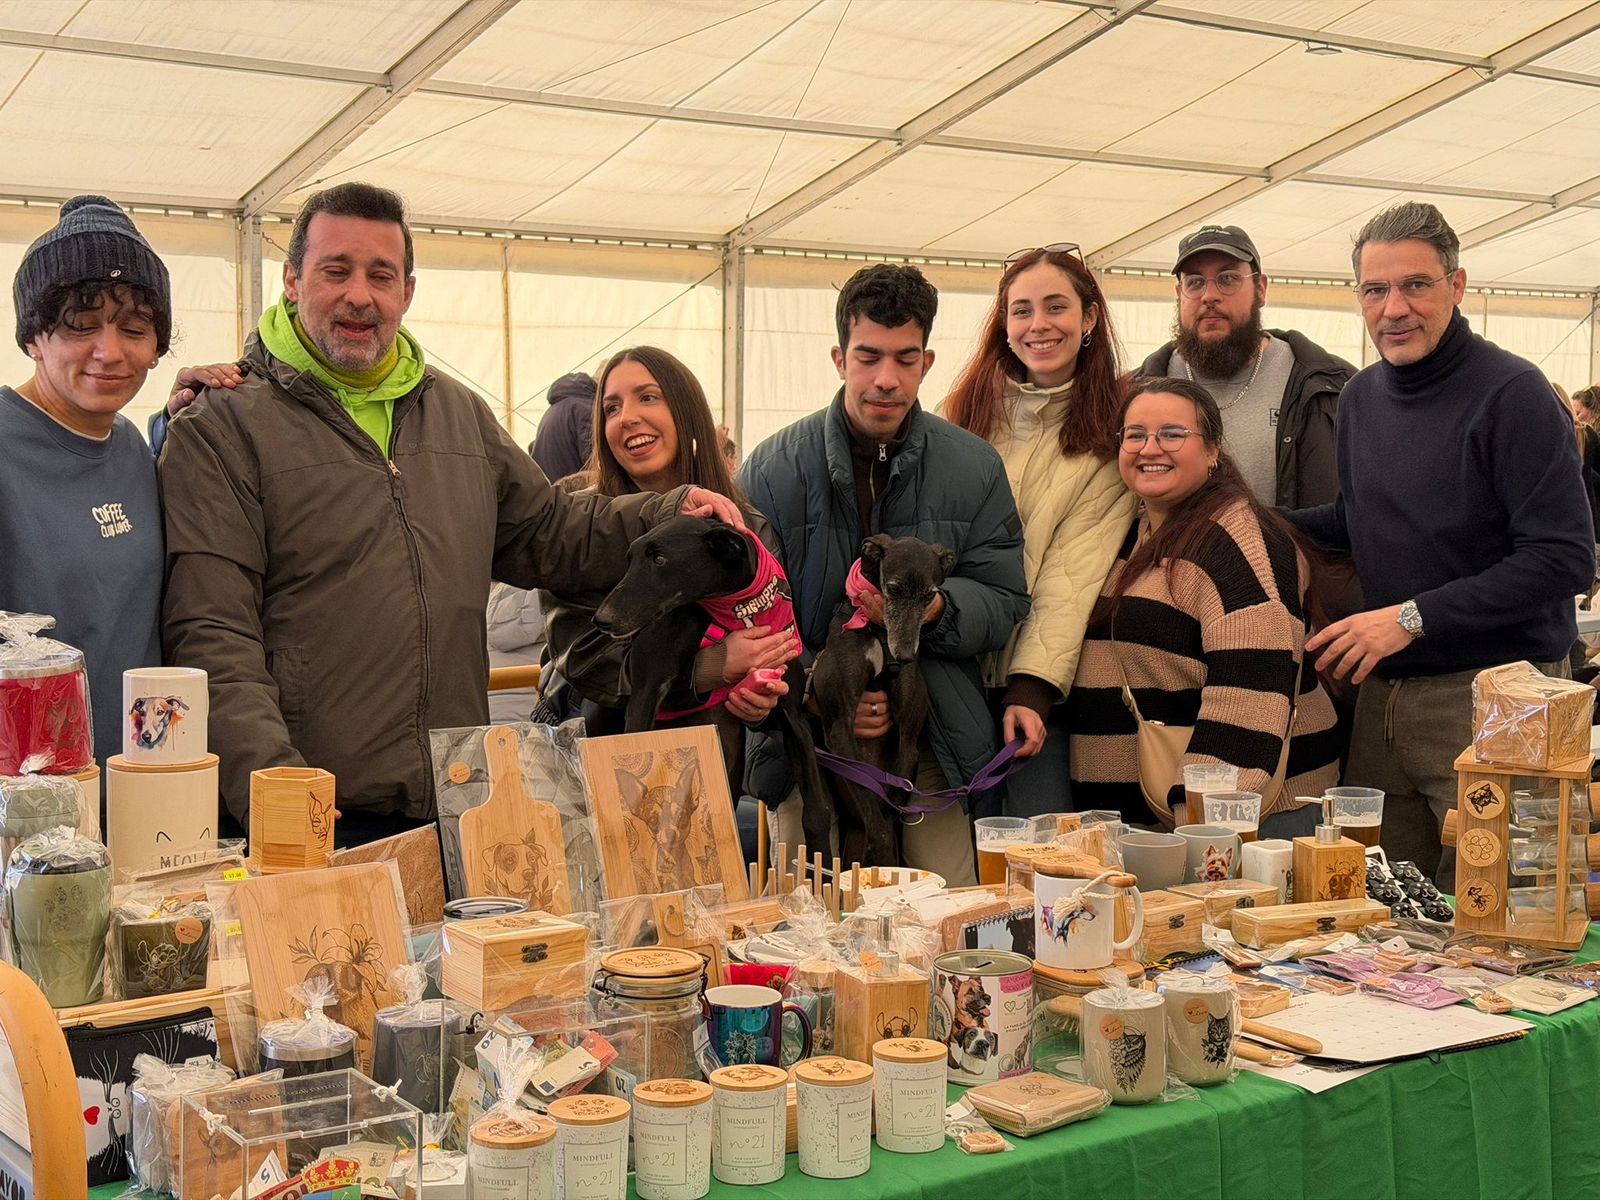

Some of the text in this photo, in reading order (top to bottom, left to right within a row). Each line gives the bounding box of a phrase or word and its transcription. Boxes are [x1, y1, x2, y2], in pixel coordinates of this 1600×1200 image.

[92, 503, 127, 524] COFFEE
[899, 1088, 938, 1097] MINDFULL
[726, 1116, 768, 1125] MINDFULL
[639, 1131, 678, 1142] MINDFULL
[572, 1152, 614, 1163] MINDFULL
[477, 1175, 519, 1187] MINDFULL
